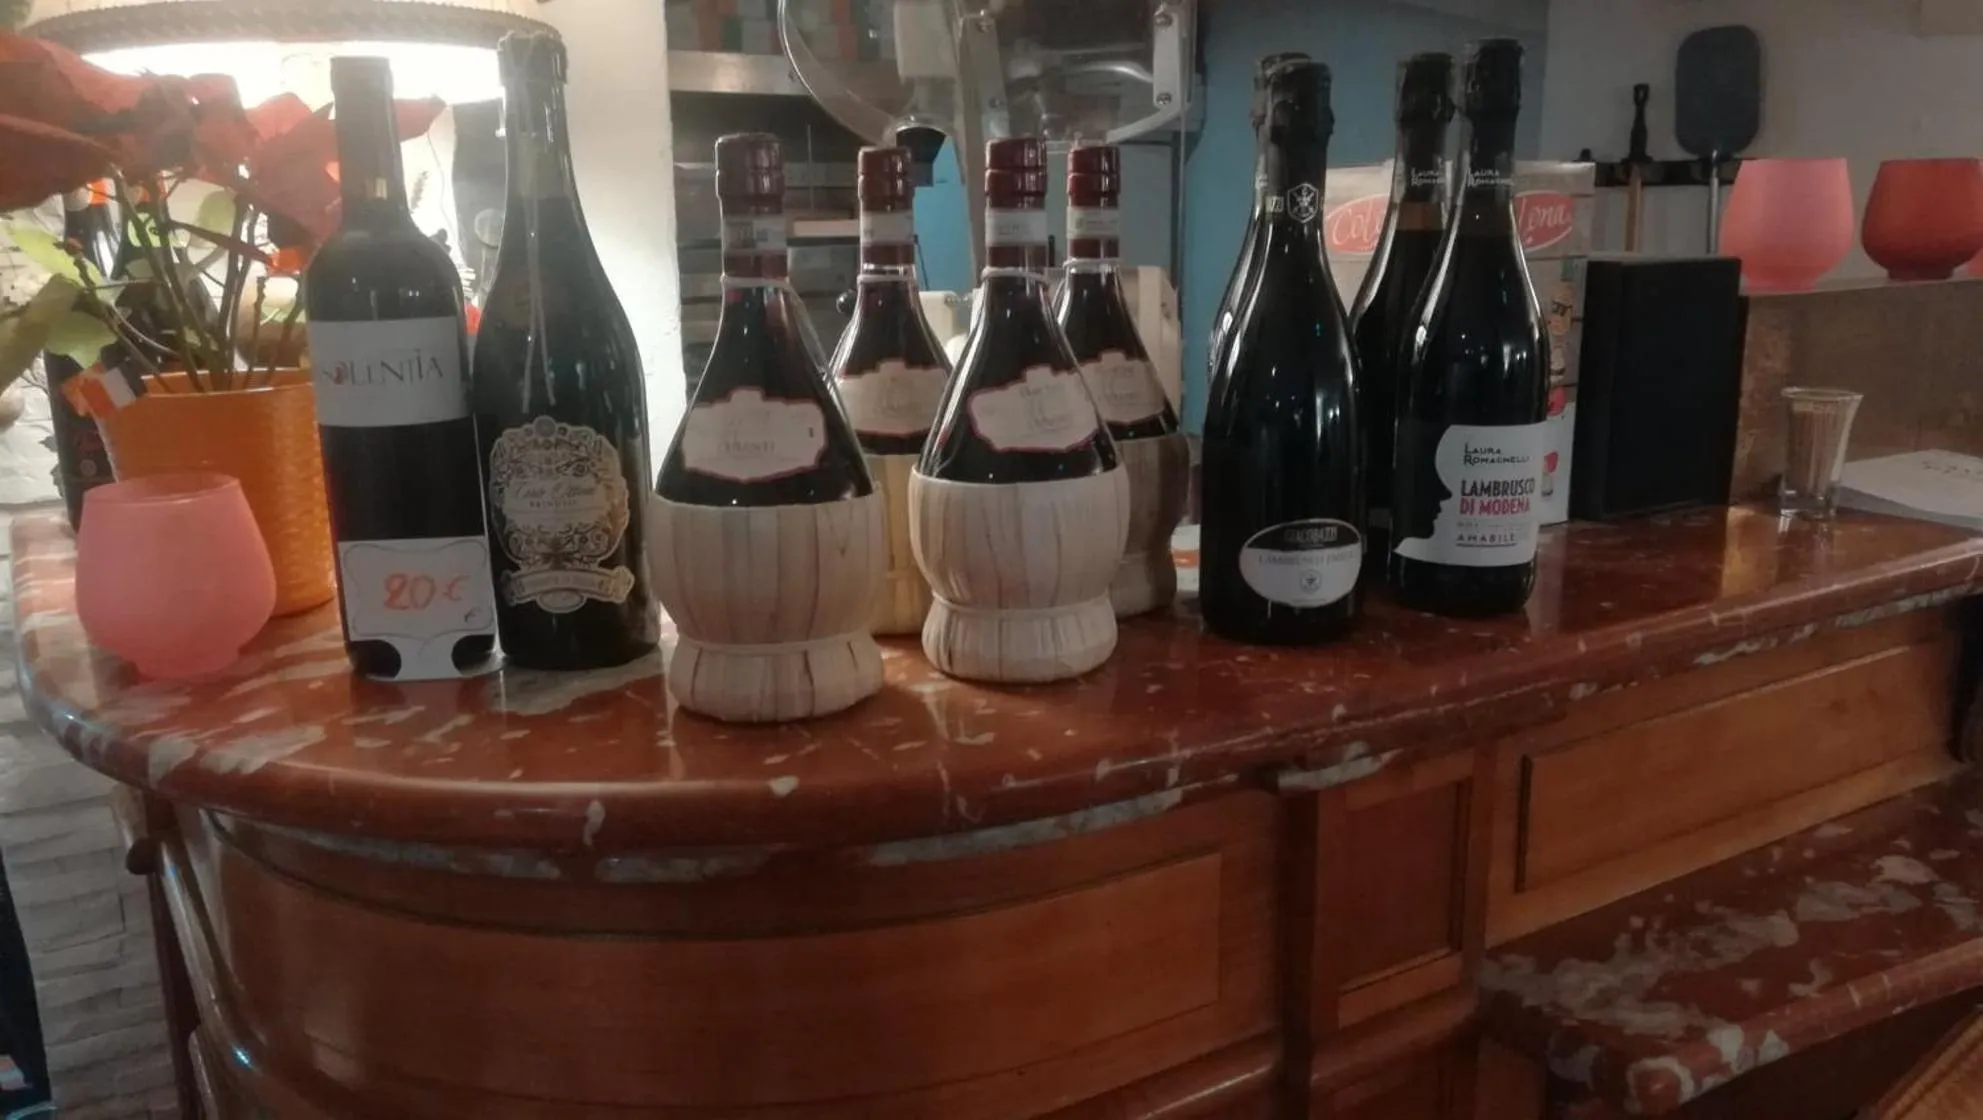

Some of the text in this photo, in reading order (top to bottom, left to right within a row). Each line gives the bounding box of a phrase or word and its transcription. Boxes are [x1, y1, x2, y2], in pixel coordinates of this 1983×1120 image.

[1463, 442, 1502, 454] LAURA
[1461, 478, 1536, 497] LAMBRUSCO
[1459, 498, 1530, 515] DI MODENA
[1457, 532, 1515, 542] AMABILE
